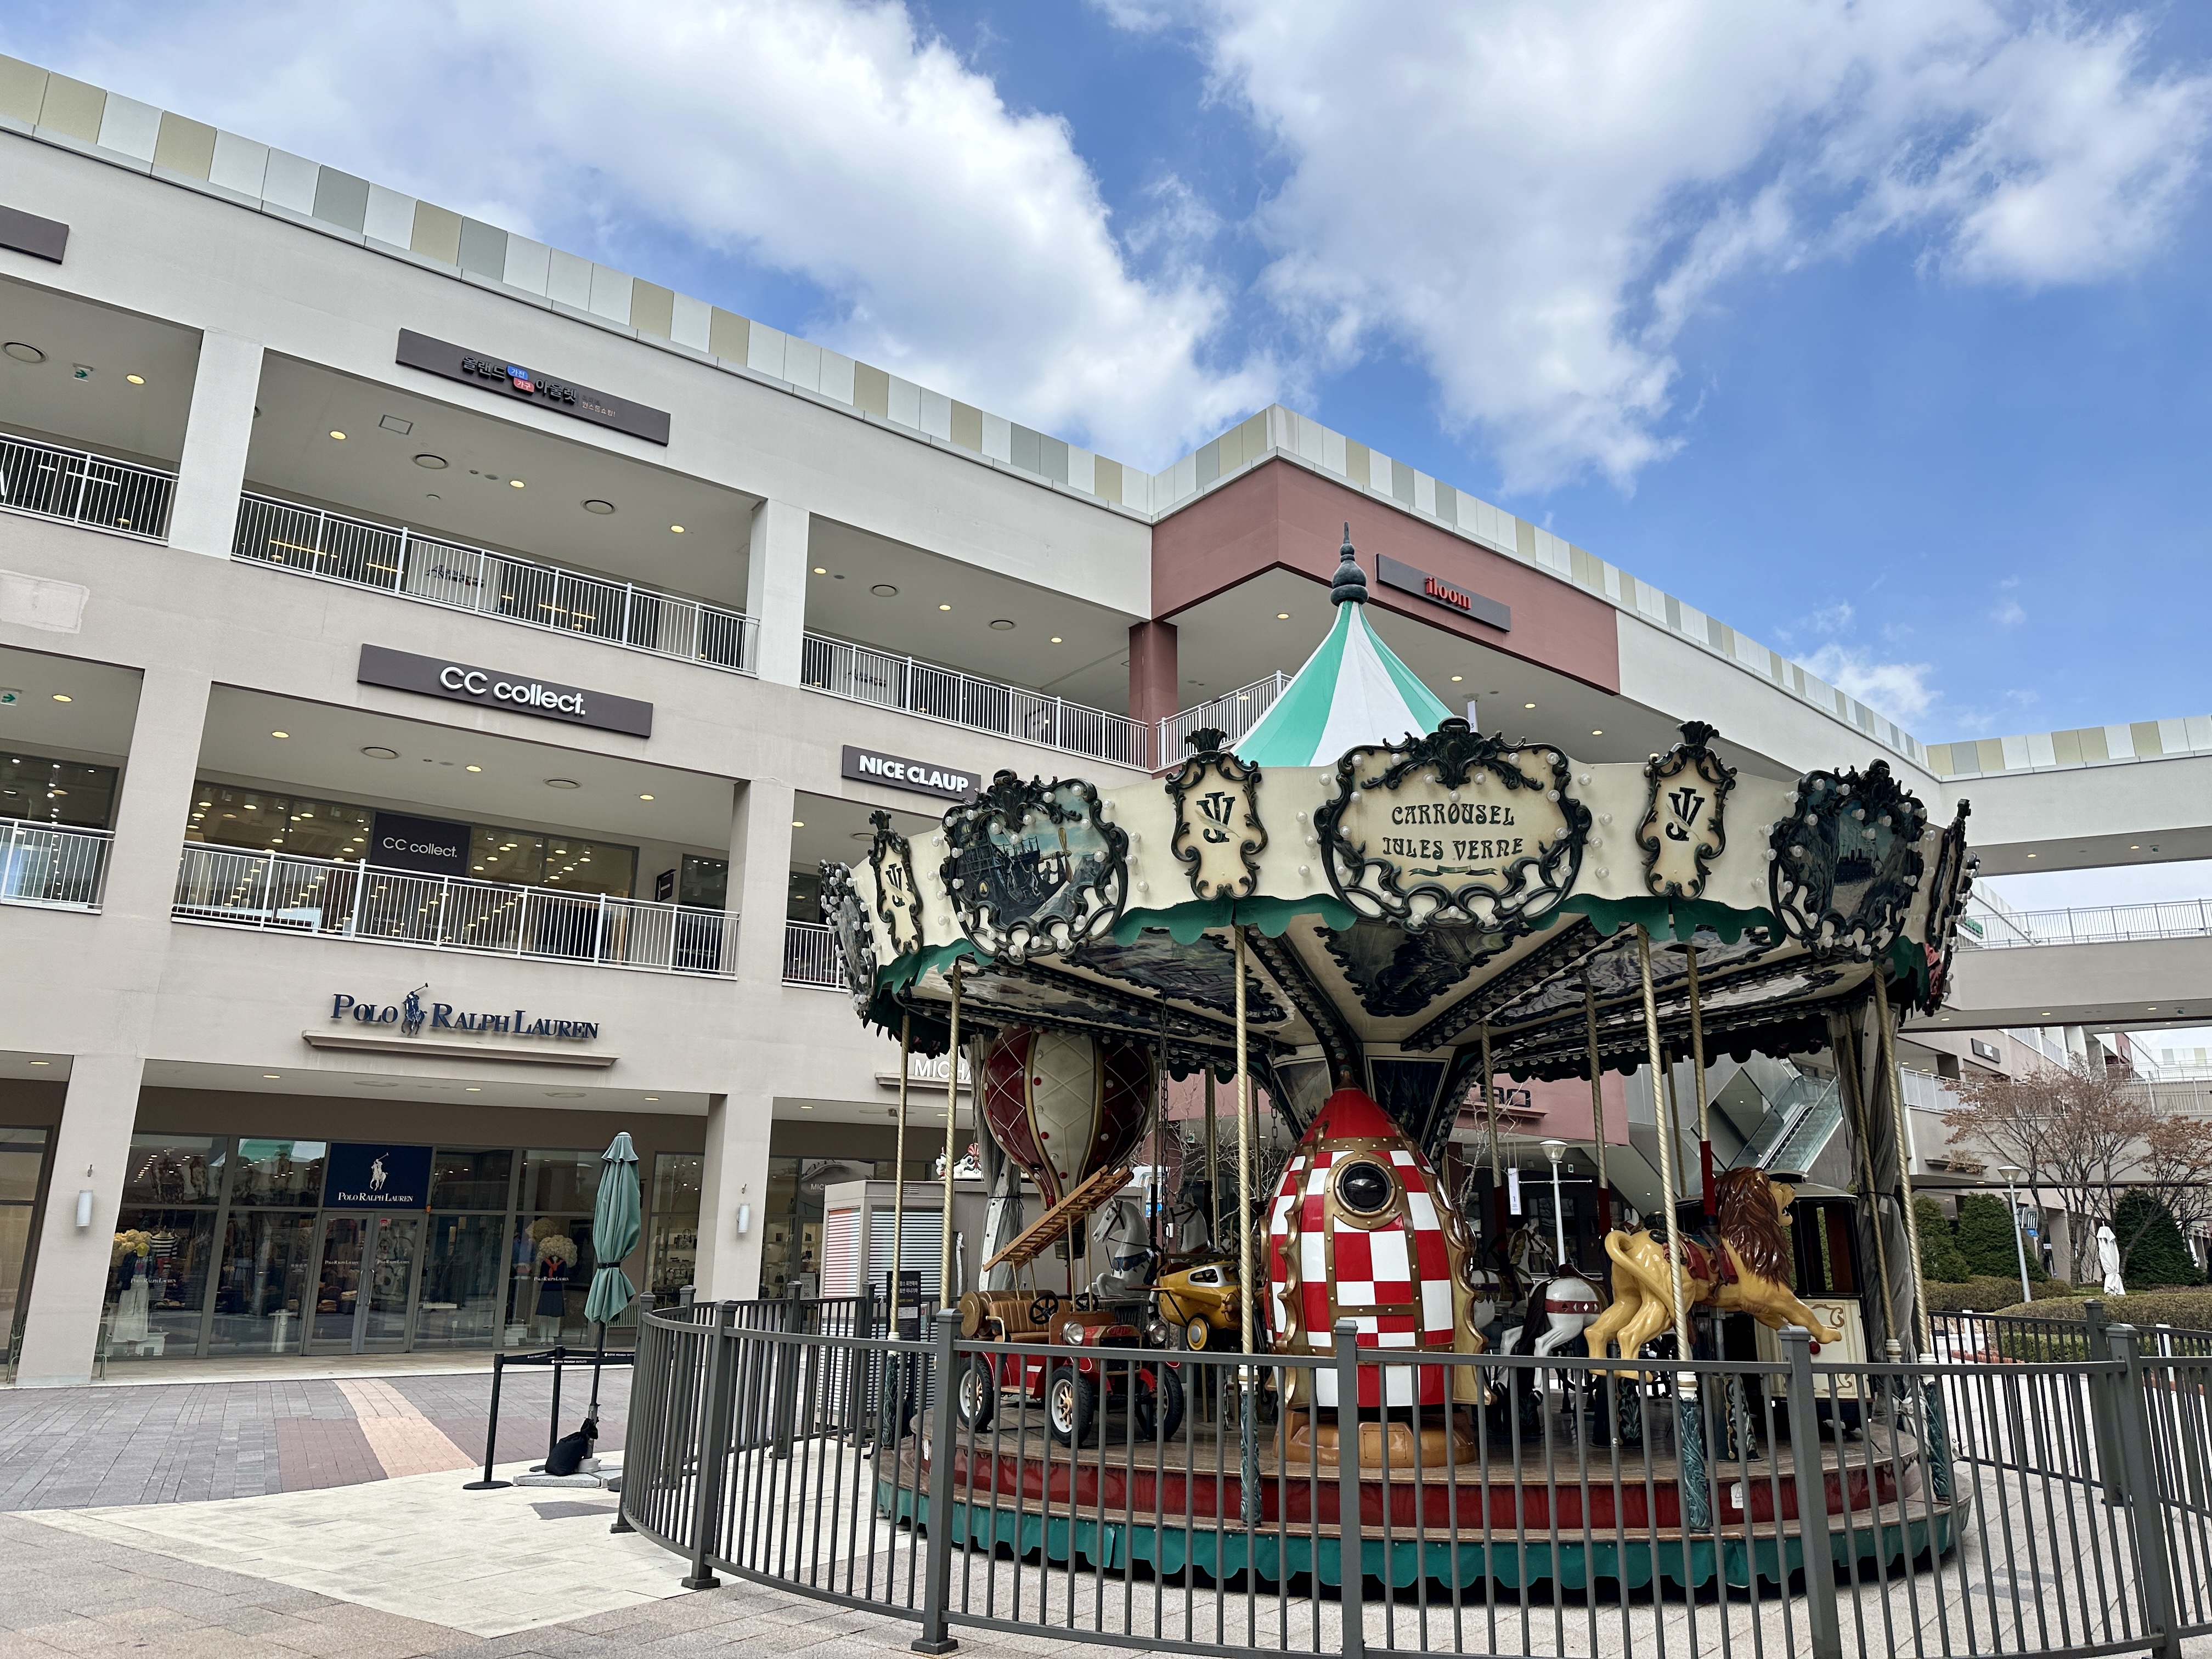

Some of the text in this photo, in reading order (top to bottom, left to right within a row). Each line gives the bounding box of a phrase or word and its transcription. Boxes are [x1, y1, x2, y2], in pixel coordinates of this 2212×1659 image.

[462, 356, 506, 381] 올랜드
[511, 368, 525, 379] 가전
[517, 380, 531, 390] 가구
[535, 380, 577, 404] 아울렛
[1425, 577, 1471, 610] iloom
[440, 667, 586, 715] CC collect.
[859, 755, 969, 792] NICE CLAUP
[1392, 803, 1515, 826] CARROUSEL
[383, 837, 458, 857] CC collect.
[1383, 837, 1524, 861] JULES VERNE
[330, 994, 600, 1039] POLO RALPH LAUREN
[338, 1192, 413, 1201] POLO RALPH LAUREN
